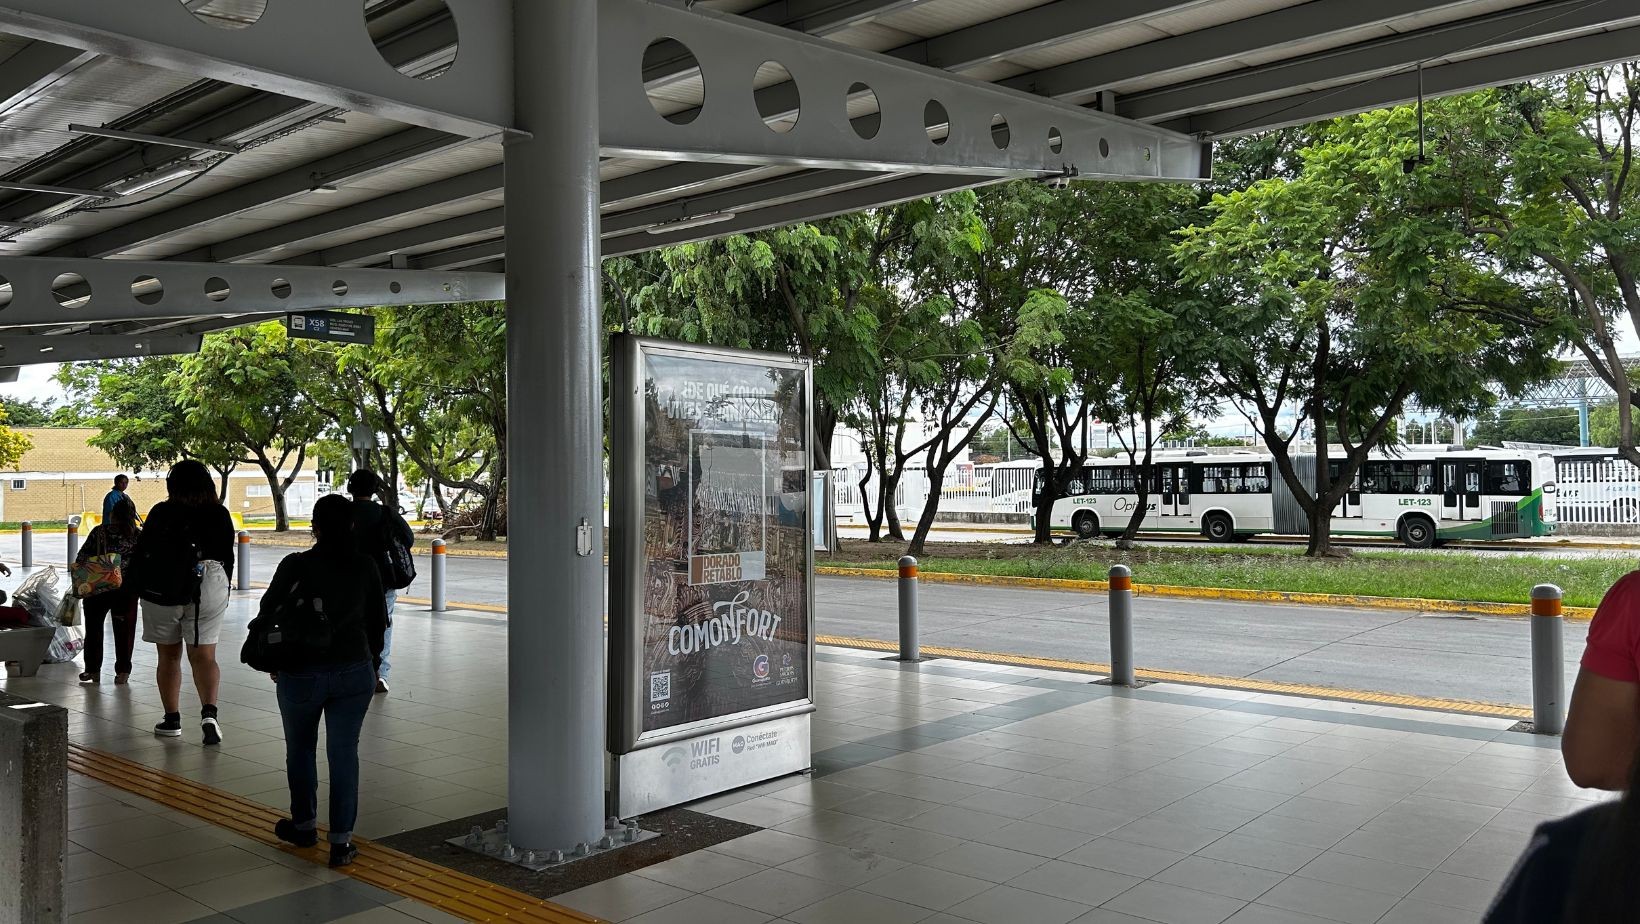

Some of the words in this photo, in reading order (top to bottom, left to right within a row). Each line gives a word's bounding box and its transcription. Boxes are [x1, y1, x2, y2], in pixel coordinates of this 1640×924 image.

[309, 318, 325, 327] X58
[1113, 497, 1157, 512] Optius
[1398, 498, 1432, 506] LET-123
[703, 553, 741, 569] DORADO
[703, 566, 743, 582] RETABLO
[668, 590, 782, 656] COMONFORT
[746, 731, 778, 744] Conéctate
[690, 737, 720, 758] WIFI
[690, 755, 720, 770] GRATIS
